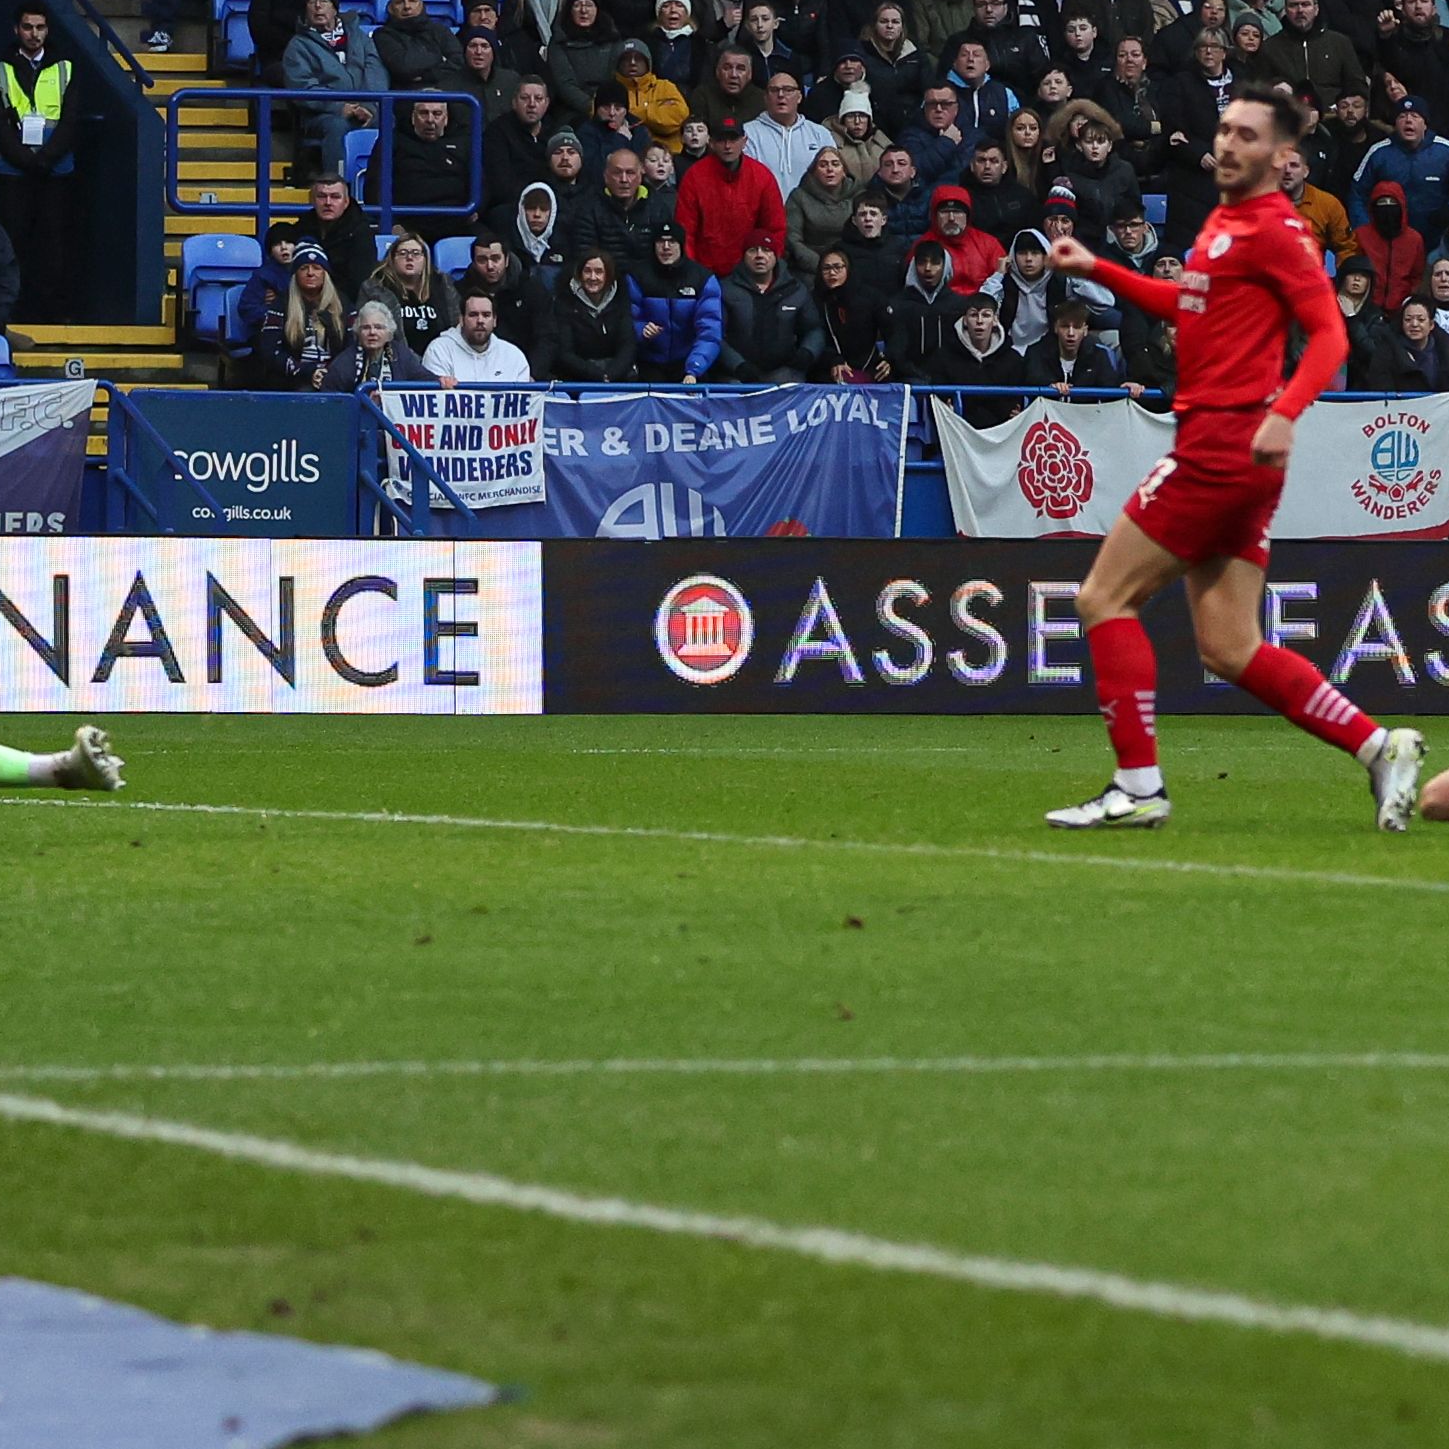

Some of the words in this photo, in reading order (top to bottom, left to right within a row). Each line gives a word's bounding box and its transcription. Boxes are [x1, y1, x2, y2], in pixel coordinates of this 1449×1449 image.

[69, 360, 82, 376] G
[0, 390, 74, 430] F.C.
[400, 394, 438, 419] WE
[444, 394, 485, 419] ARE
[493, 393, 531, 418] THE
[602, 423, 629, 456] &
[646, 415, 777, 453] DEANE
[789, 392, 889, 433] LOYAL
[440, 425, 483, 450] AND
[488, 418, 539, 450] ONLY
[1362, 412, 1431, 438] BOLTON
[1352, 467, 1442, 520] WANDERERS
[775, 575, 1083, 686] ASSE
